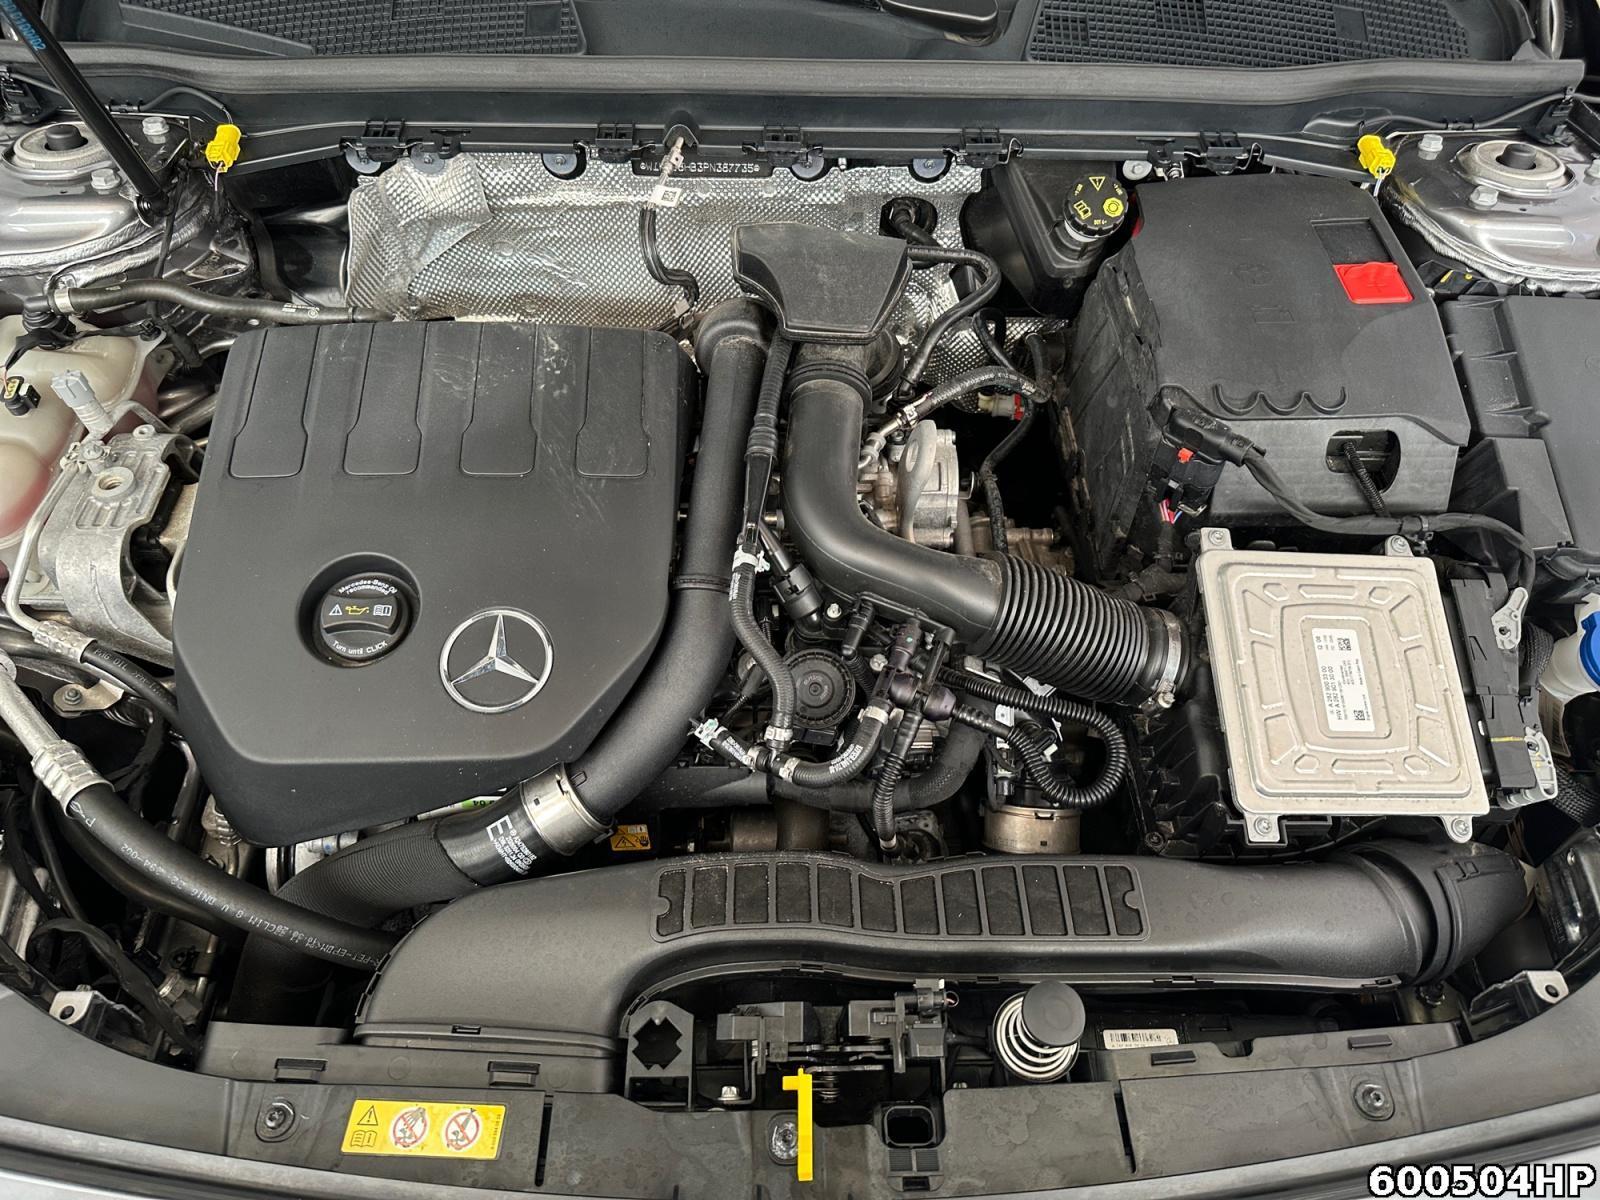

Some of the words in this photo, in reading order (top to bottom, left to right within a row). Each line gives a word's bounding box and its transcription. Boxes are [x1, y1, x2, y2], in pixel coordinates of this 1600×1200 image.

[338, 579, 389, 593] Mercedes-Benz
[346, 585, 389, 594] recommended
[332, 640, 346, 651] Turn
[366, 640, 387, 653] CLICK
